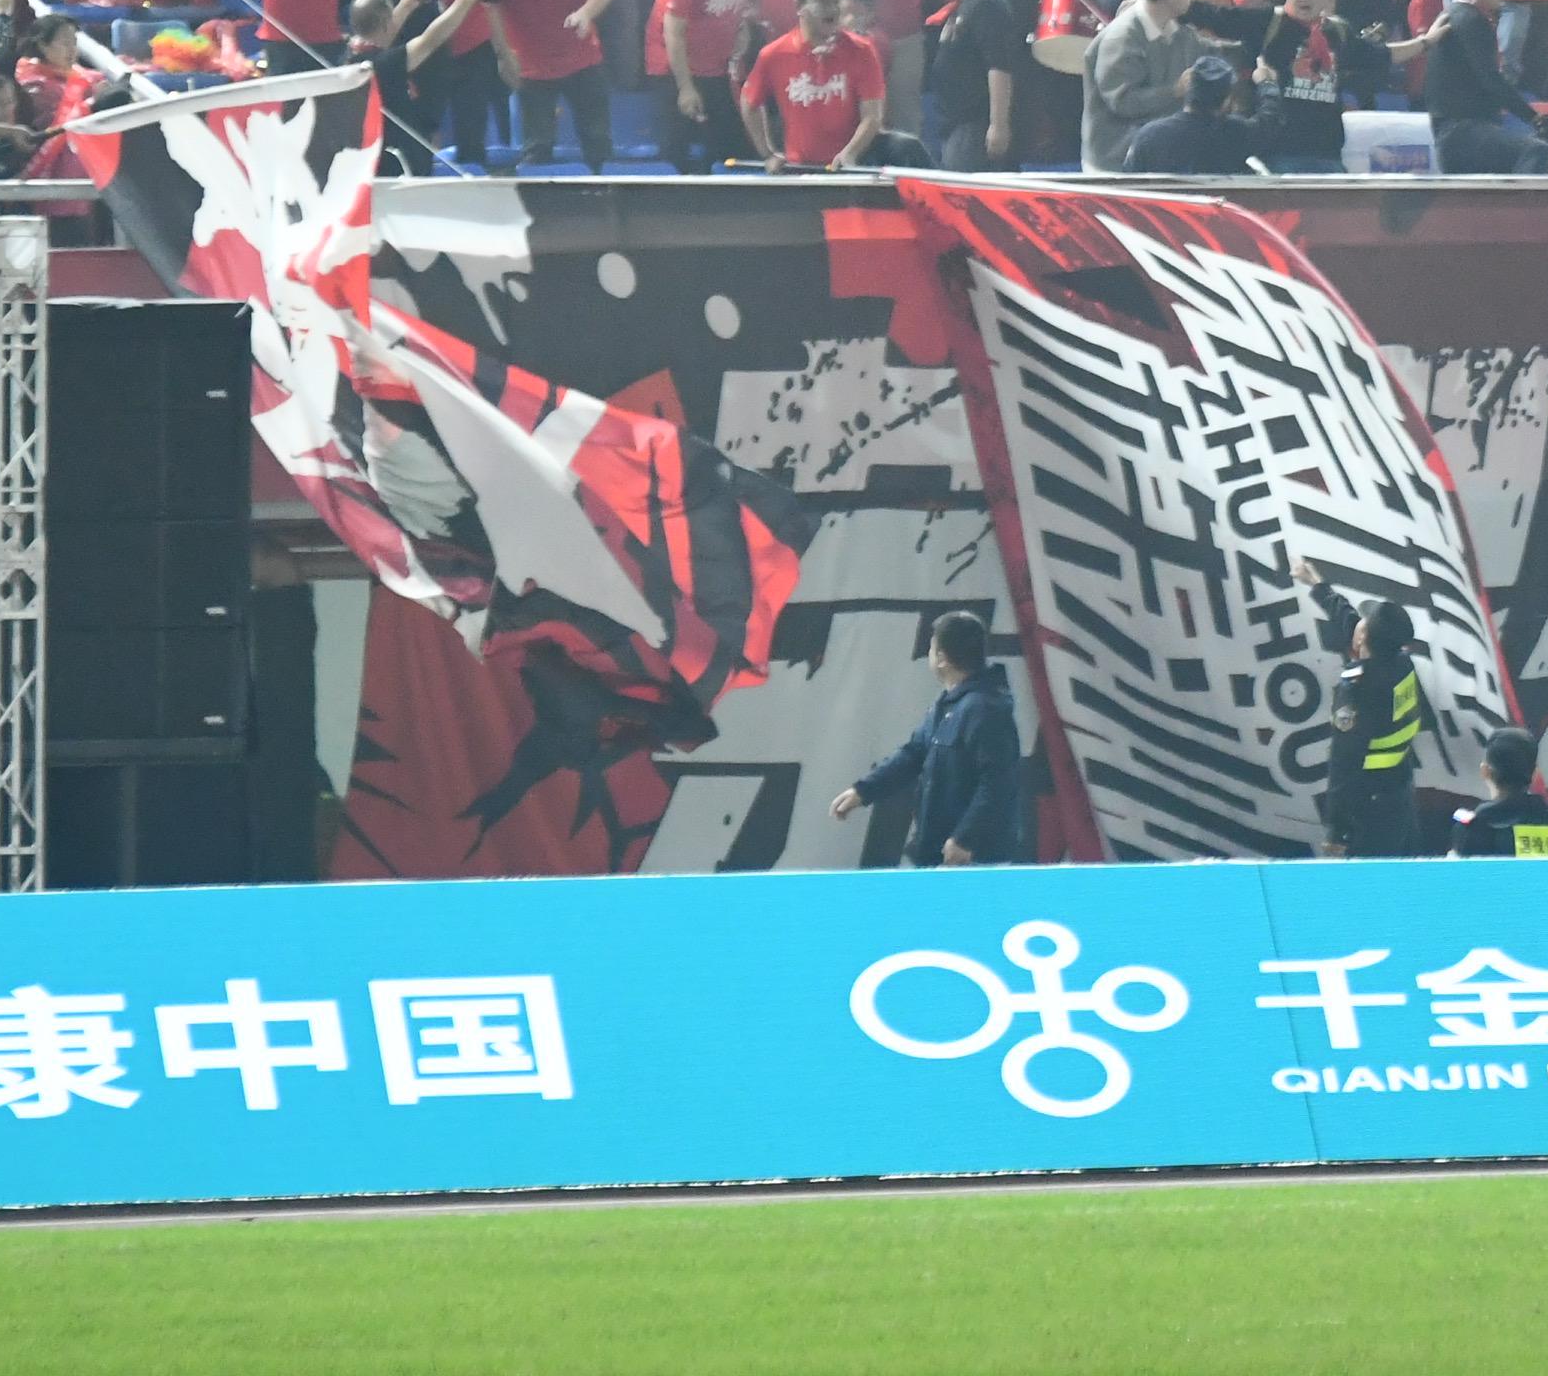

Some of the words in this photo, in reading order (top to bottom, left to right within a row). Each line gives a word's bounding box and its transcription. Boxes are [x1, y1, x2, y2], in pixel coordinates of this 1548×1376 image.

[785, 72, 848, 106] 株洲
[1184, 366, 1334, 789] ZHUZHOU
[1271, 1060, 1528, 1097] QIANJIN
